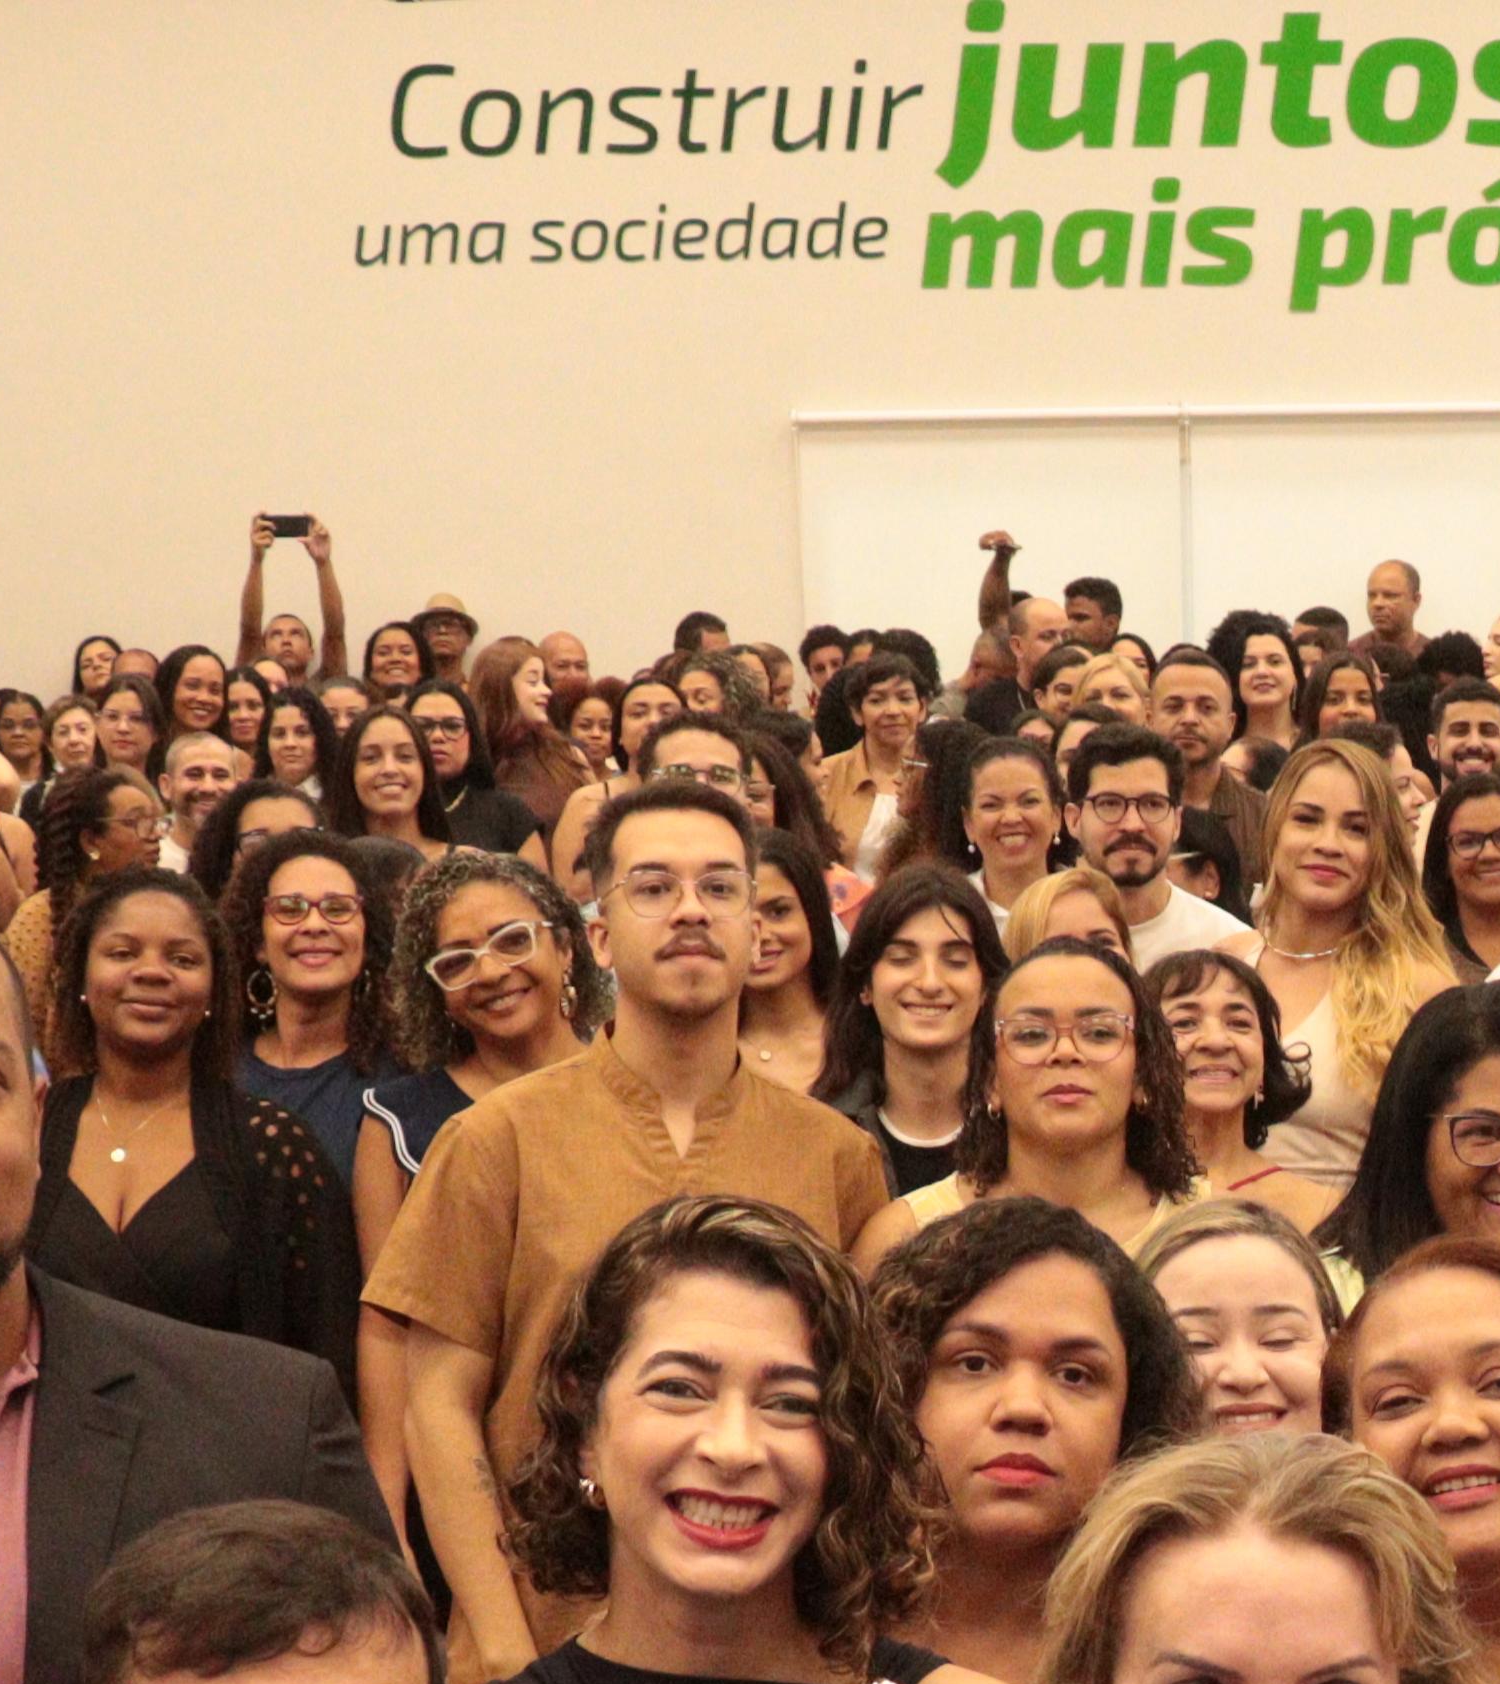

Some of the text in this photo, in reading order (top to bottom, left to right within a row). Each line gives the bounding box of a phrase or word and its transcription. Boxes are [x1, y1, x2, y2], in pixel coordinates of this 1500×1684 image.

[390, 60, 924, 159] Construir
[355, 222, 506, 268] uma
[531, 201, 889, 264] sociedade
[922, 177, 1255, 289] mais
